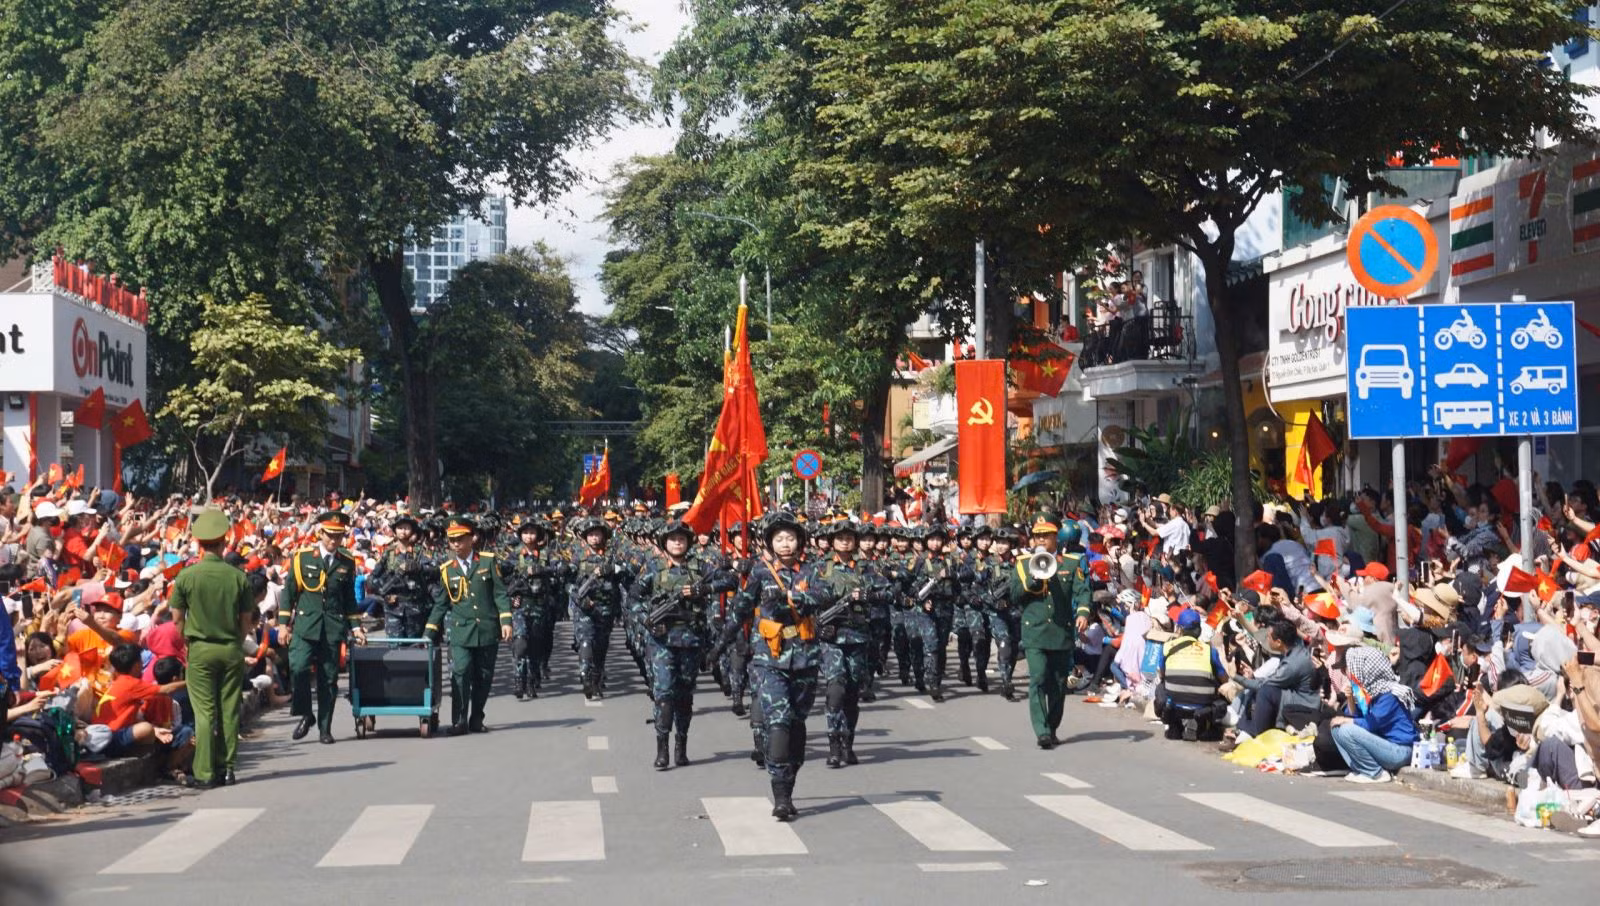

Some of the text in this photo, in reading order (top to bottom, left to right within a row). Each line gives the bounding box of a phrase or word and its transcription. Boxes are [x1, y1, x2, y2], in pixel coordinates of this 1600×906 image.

[1519, 170, 1546, 264] 7
[72, 317, 134, 388] OnPoint
[1508, 406, 1573, 427] XE 2 VÀ 3 BÁNH
